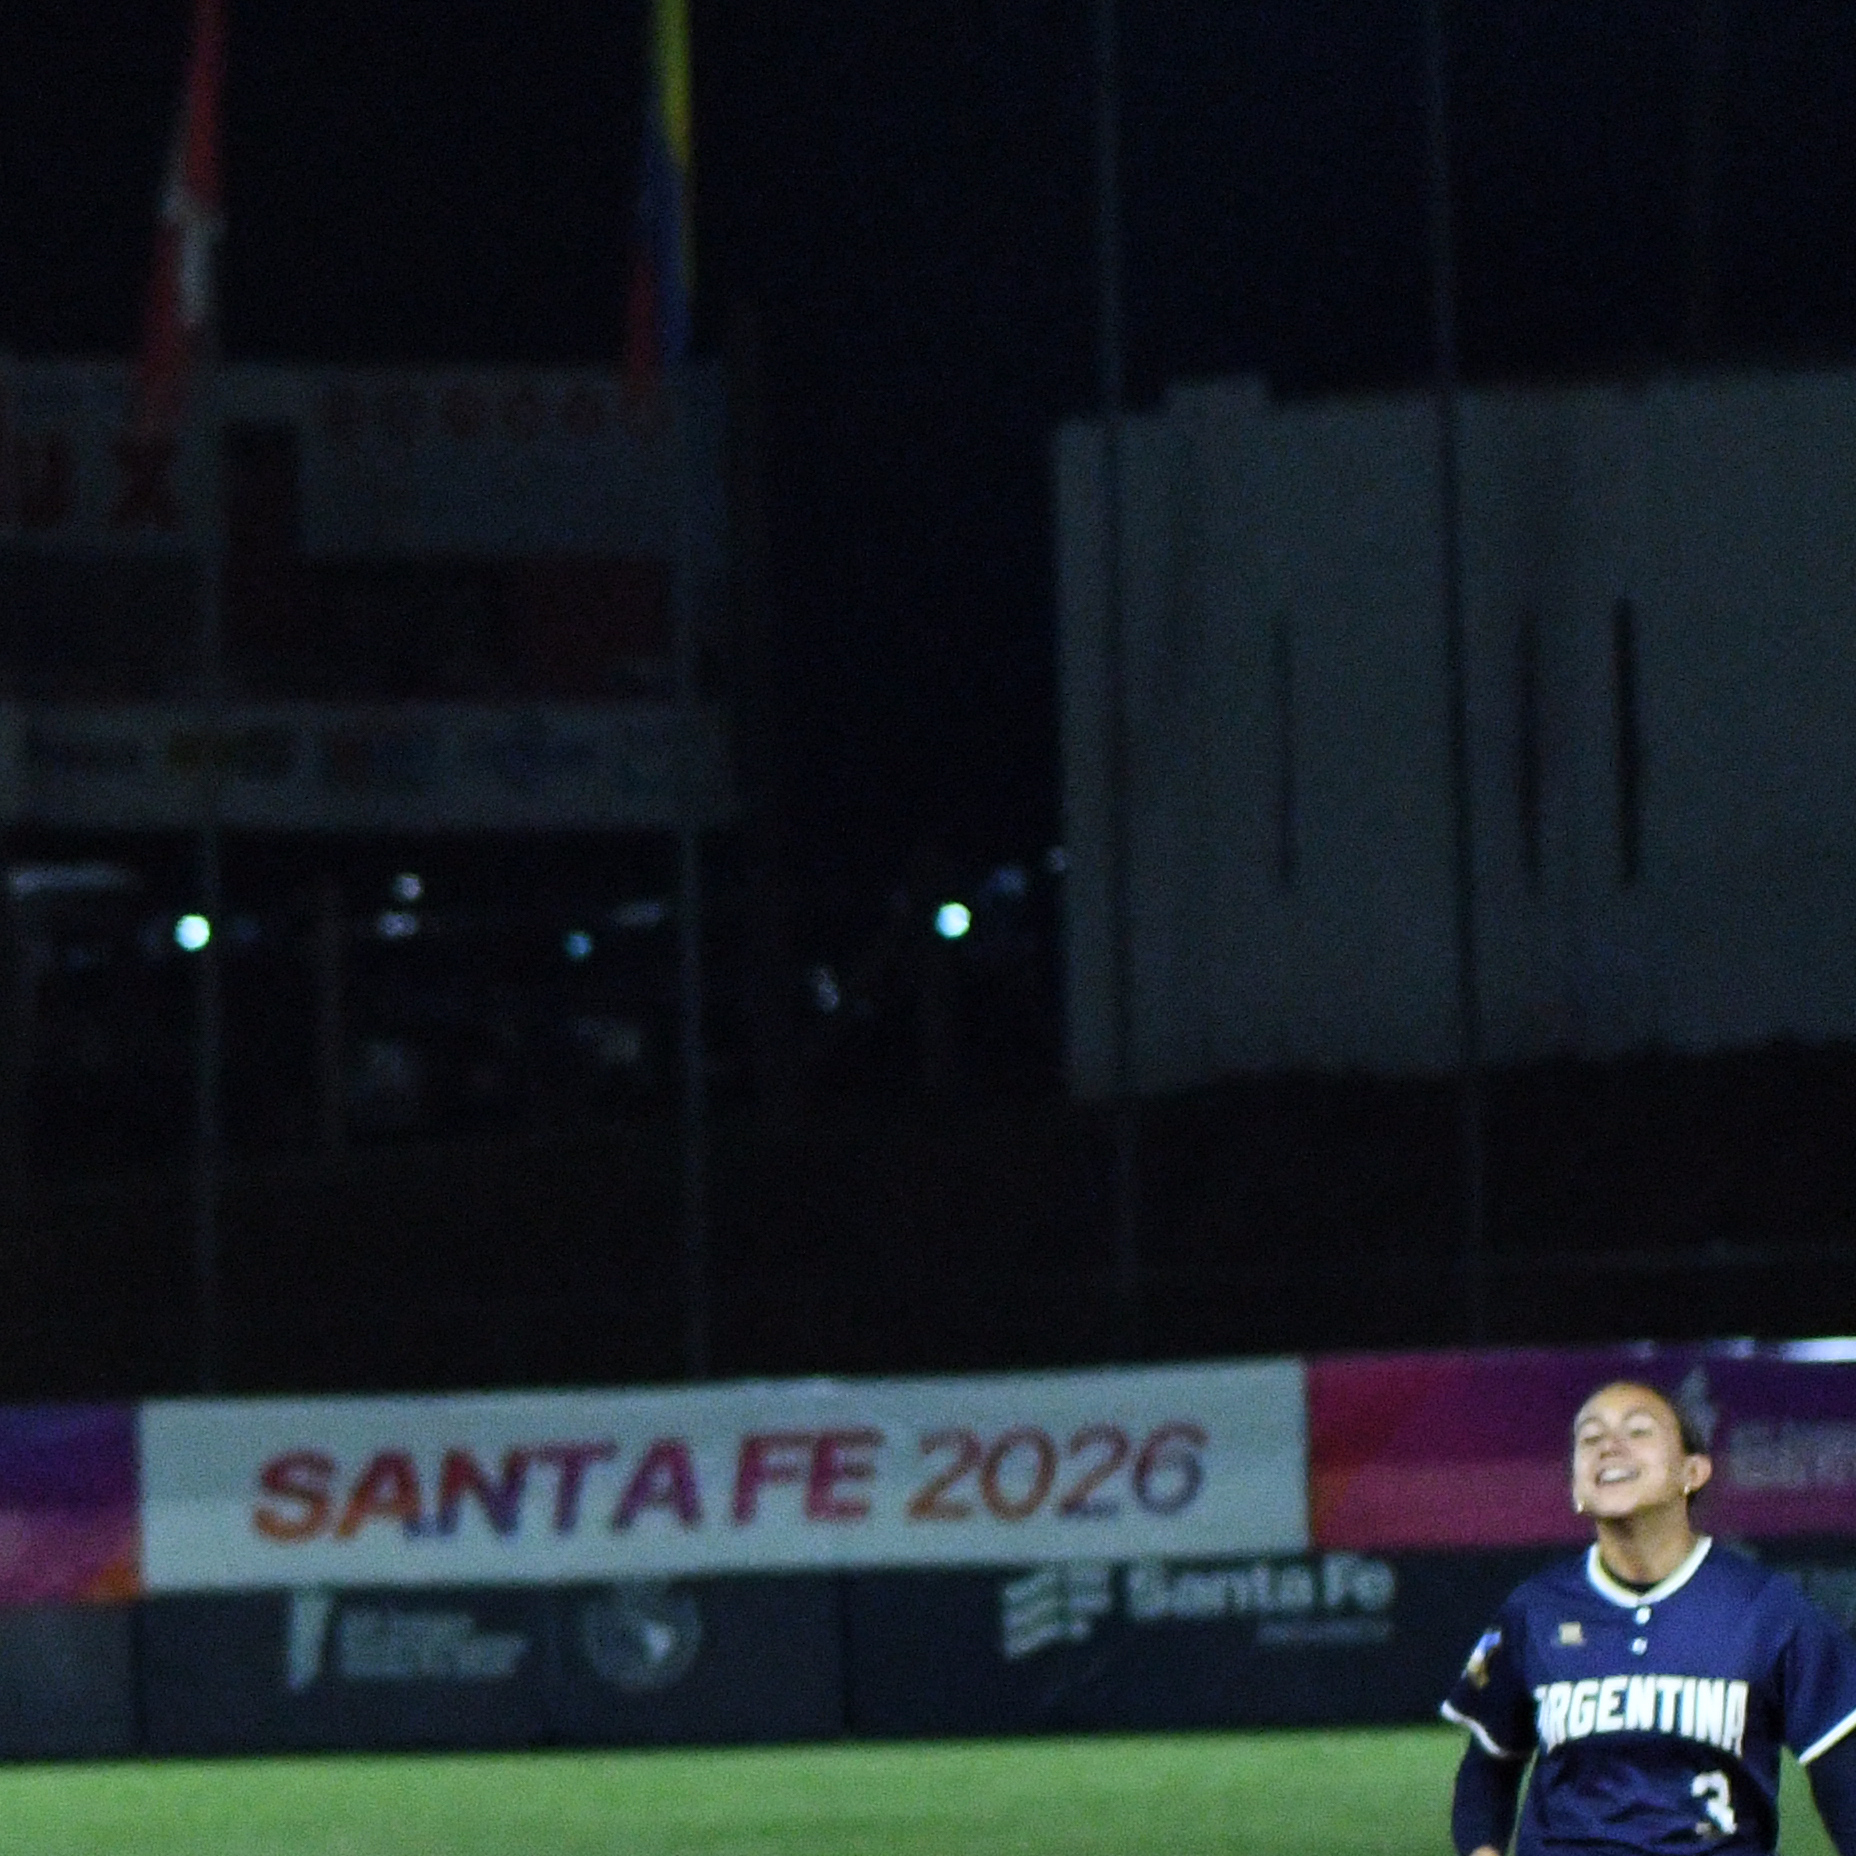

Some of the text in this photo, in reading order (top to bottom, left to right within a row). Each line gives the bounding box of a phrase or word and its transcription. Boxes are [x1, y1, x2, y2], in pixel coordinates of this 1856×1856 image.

[252, 1419, 1208, 1546] SANTA FE 2026
[1534, 1674, 1749, 1759] ARGENTINA
